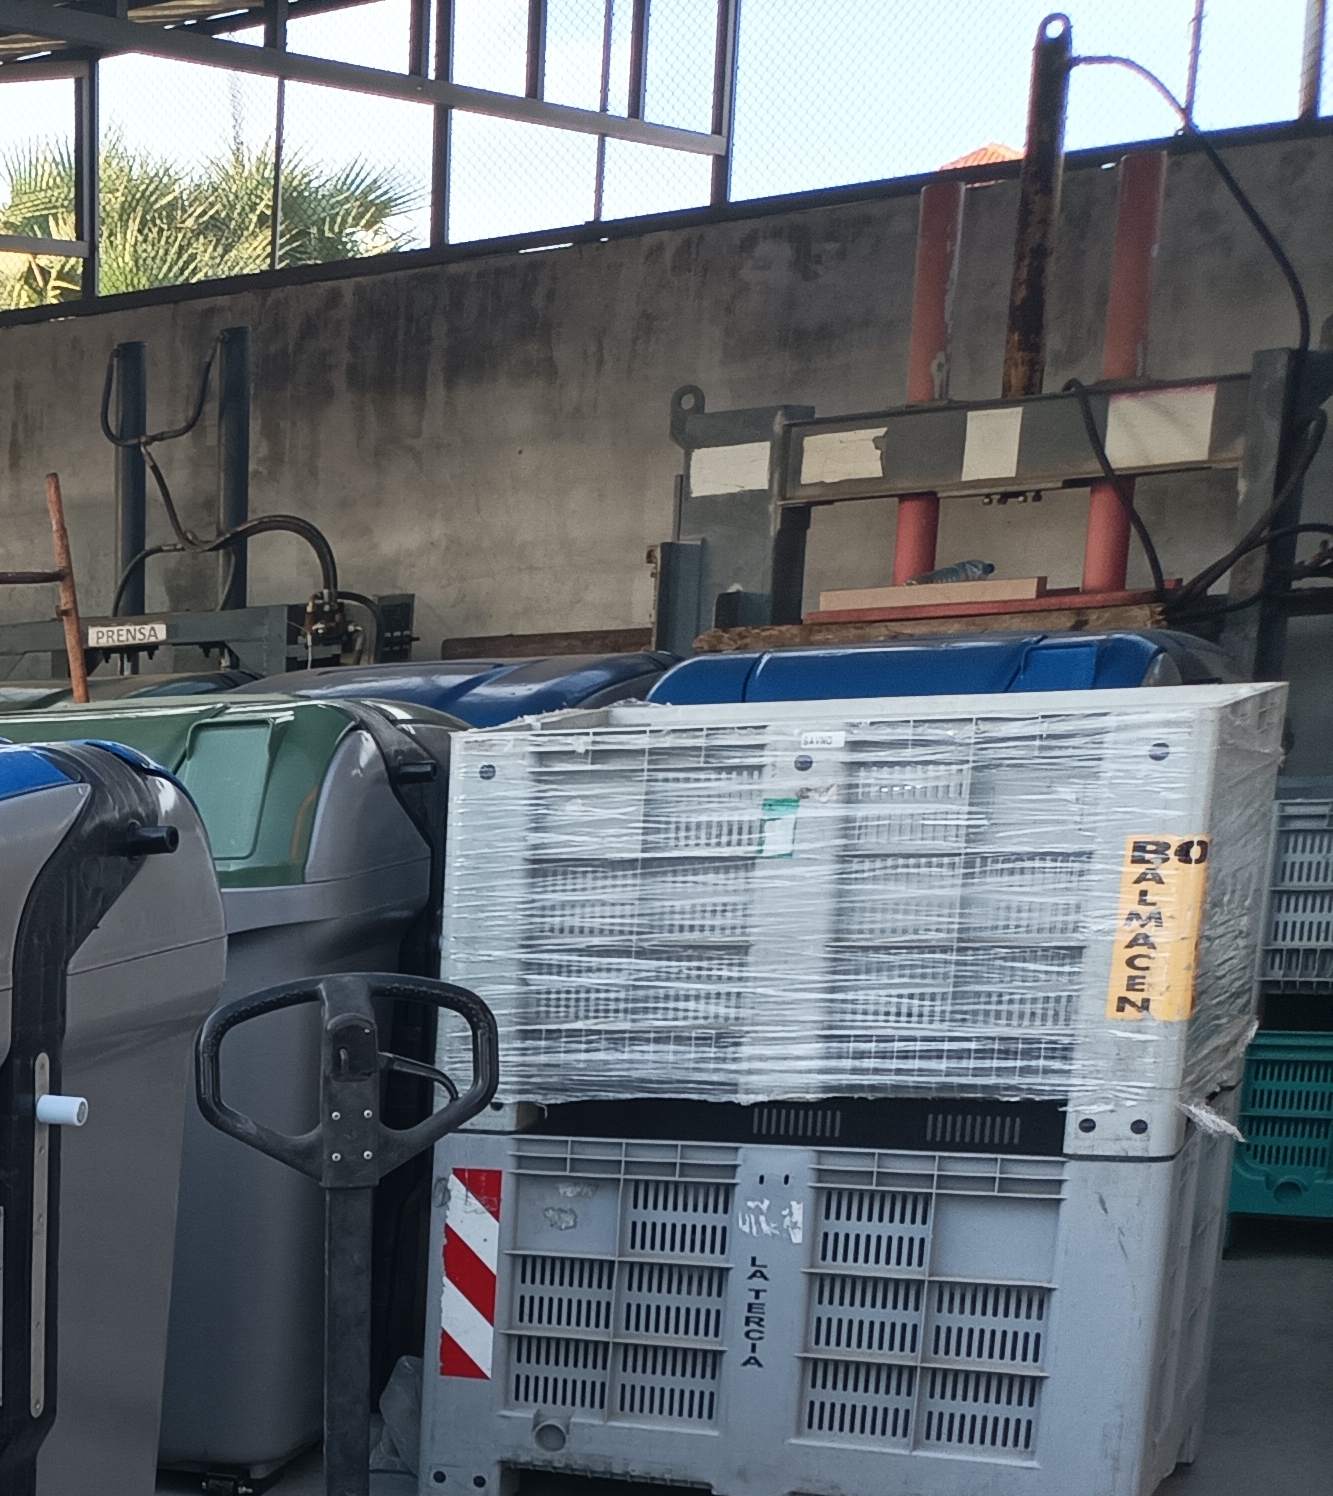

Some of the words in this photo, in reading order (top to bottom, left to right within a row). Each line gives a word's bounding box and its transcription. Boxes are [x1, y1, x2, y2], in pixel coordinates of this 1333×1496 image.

[96, 626, 159, 645] PRENSA
[746, 1256, 770, 1281] LA
[740, 1288, 768, 1368] TERCIA
